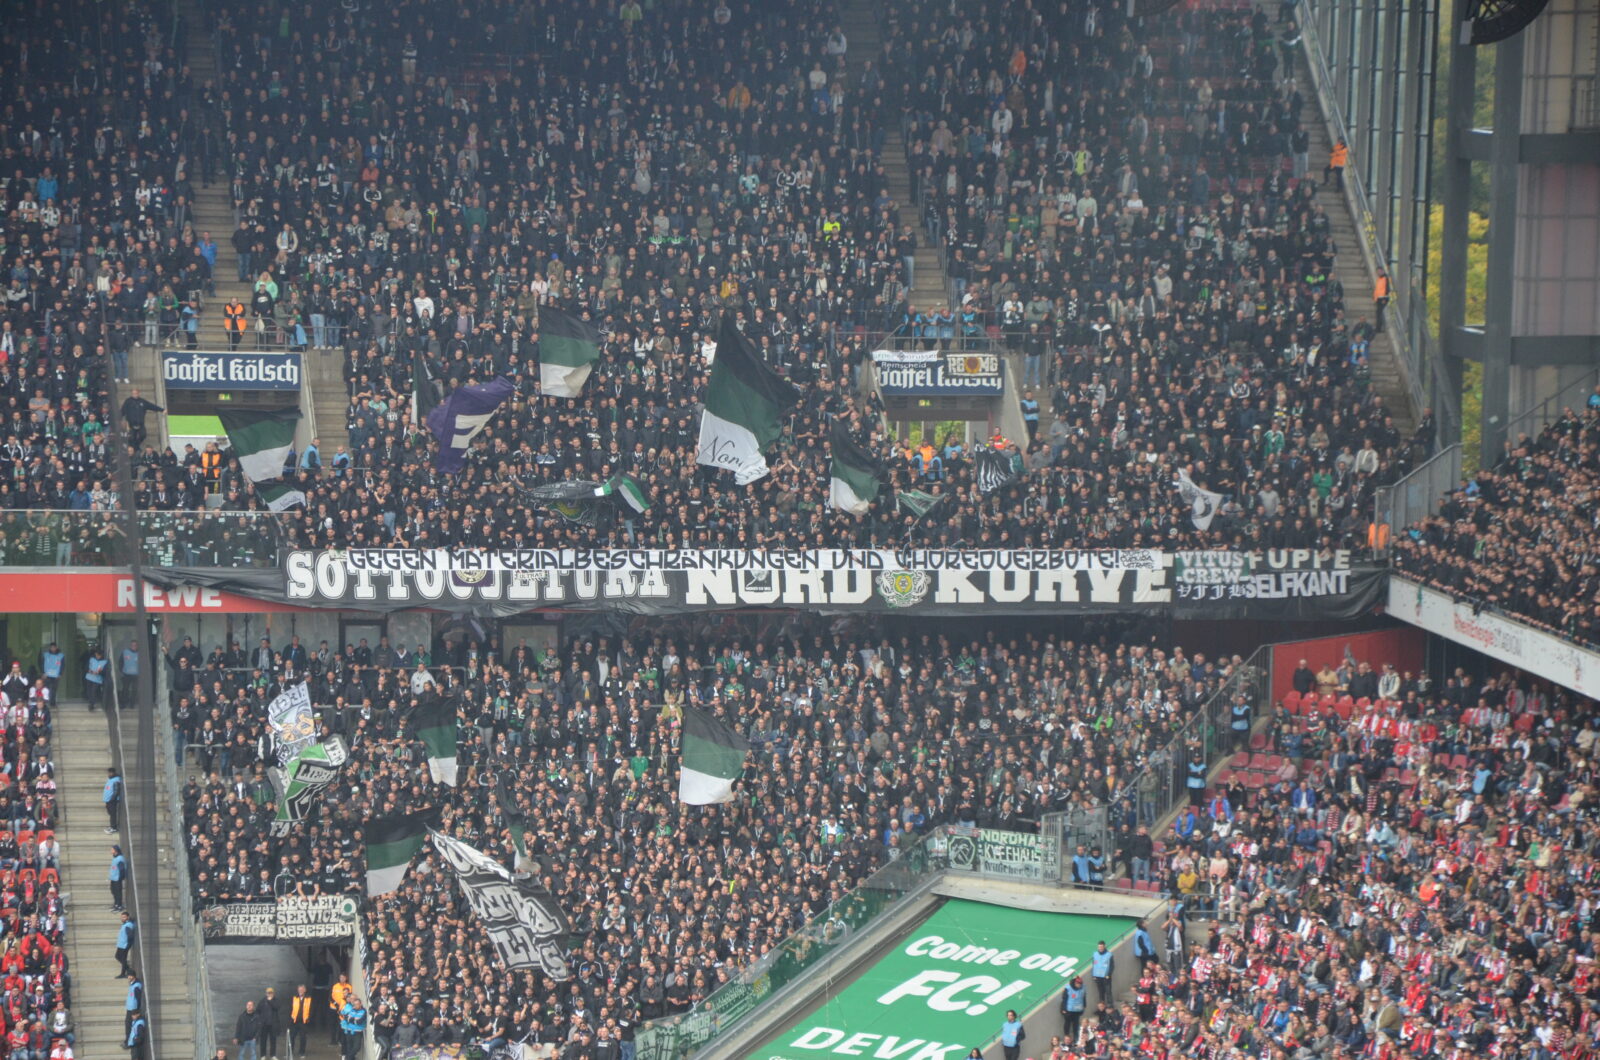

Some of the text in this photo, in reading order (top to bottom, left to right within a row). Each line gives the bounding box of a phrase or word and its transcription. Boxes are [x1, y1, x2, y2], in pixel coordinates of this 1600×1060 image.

[164, 354, 299, 385] Gaffel Kölsch
[350, 549, 436, 570] GEGEN
[450, 550, 816, 570] MATERIALBESCHRÄNKUNGEN
[832, 550, 883, 570] UND
[1180, 551, 1244, 569] VITUS
[1183, 569, 1241, 584] CREW
[1246, 570, 1351, 599] SELFKANT
[118, 579, 222, 607] REWE
[277, 896, 344, 910] BEGLEIT
[227, 914, 274, 925] GEHT
[277, 910, 341, 924] SERVICE
[225, 925, 275, 936] EINIGES
[905, 936, 1078, 977] Come on,
[876, 970, 1032, 1016] FC!
[789, 1026, 966, 1060] DEVK
